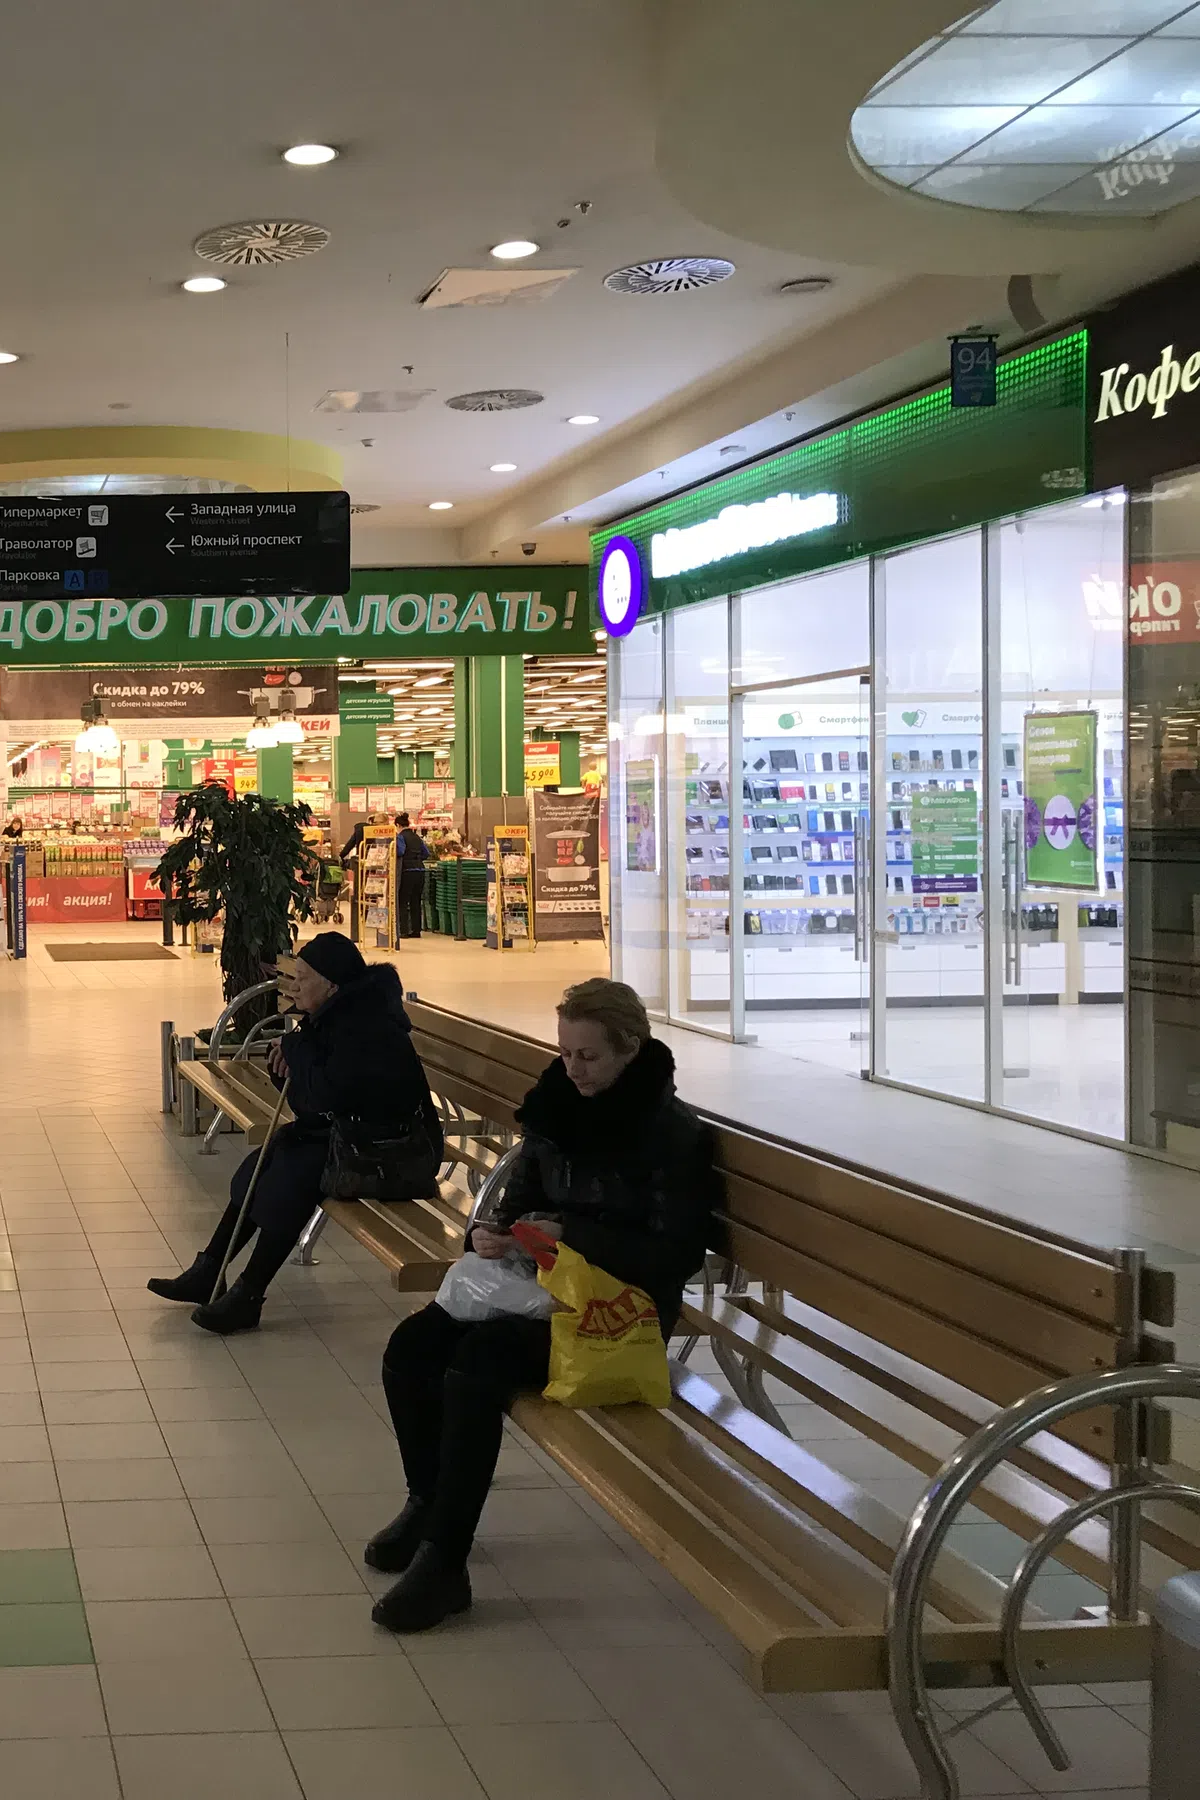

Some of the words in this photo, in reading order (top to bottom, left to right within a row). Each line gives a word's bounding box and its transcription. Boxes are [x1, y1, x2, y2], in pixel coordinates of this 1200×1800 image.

[957, 347, 992, 373] 94
[1094, 344, 1200, 423] Кофе
[191, 503, 253, 516] Западная
[257, 503, 296, 517] улица
[227, 517, 251, 525] street
[191, 534, 240, 547] Южный
[243, 534, 303, 548] проспект
[188, 590, 578, 638] ПОЖАЛОВАТЬ!
[92, 682, 147, 697] Скидка
[150, 685, 169, 698] до
[171, 680, 206, 695] 79%
[117, 699, 140, 708] обмен
[152, 699, 187, 708] наклейки
[300, 718, 331, 731] КЕЙ
[541, 885, 568, 894] Скидка
[568, 885, 578, 893] до
[579, 883, 597, 892] 79%
[63, 893, 113, 907] акция!
